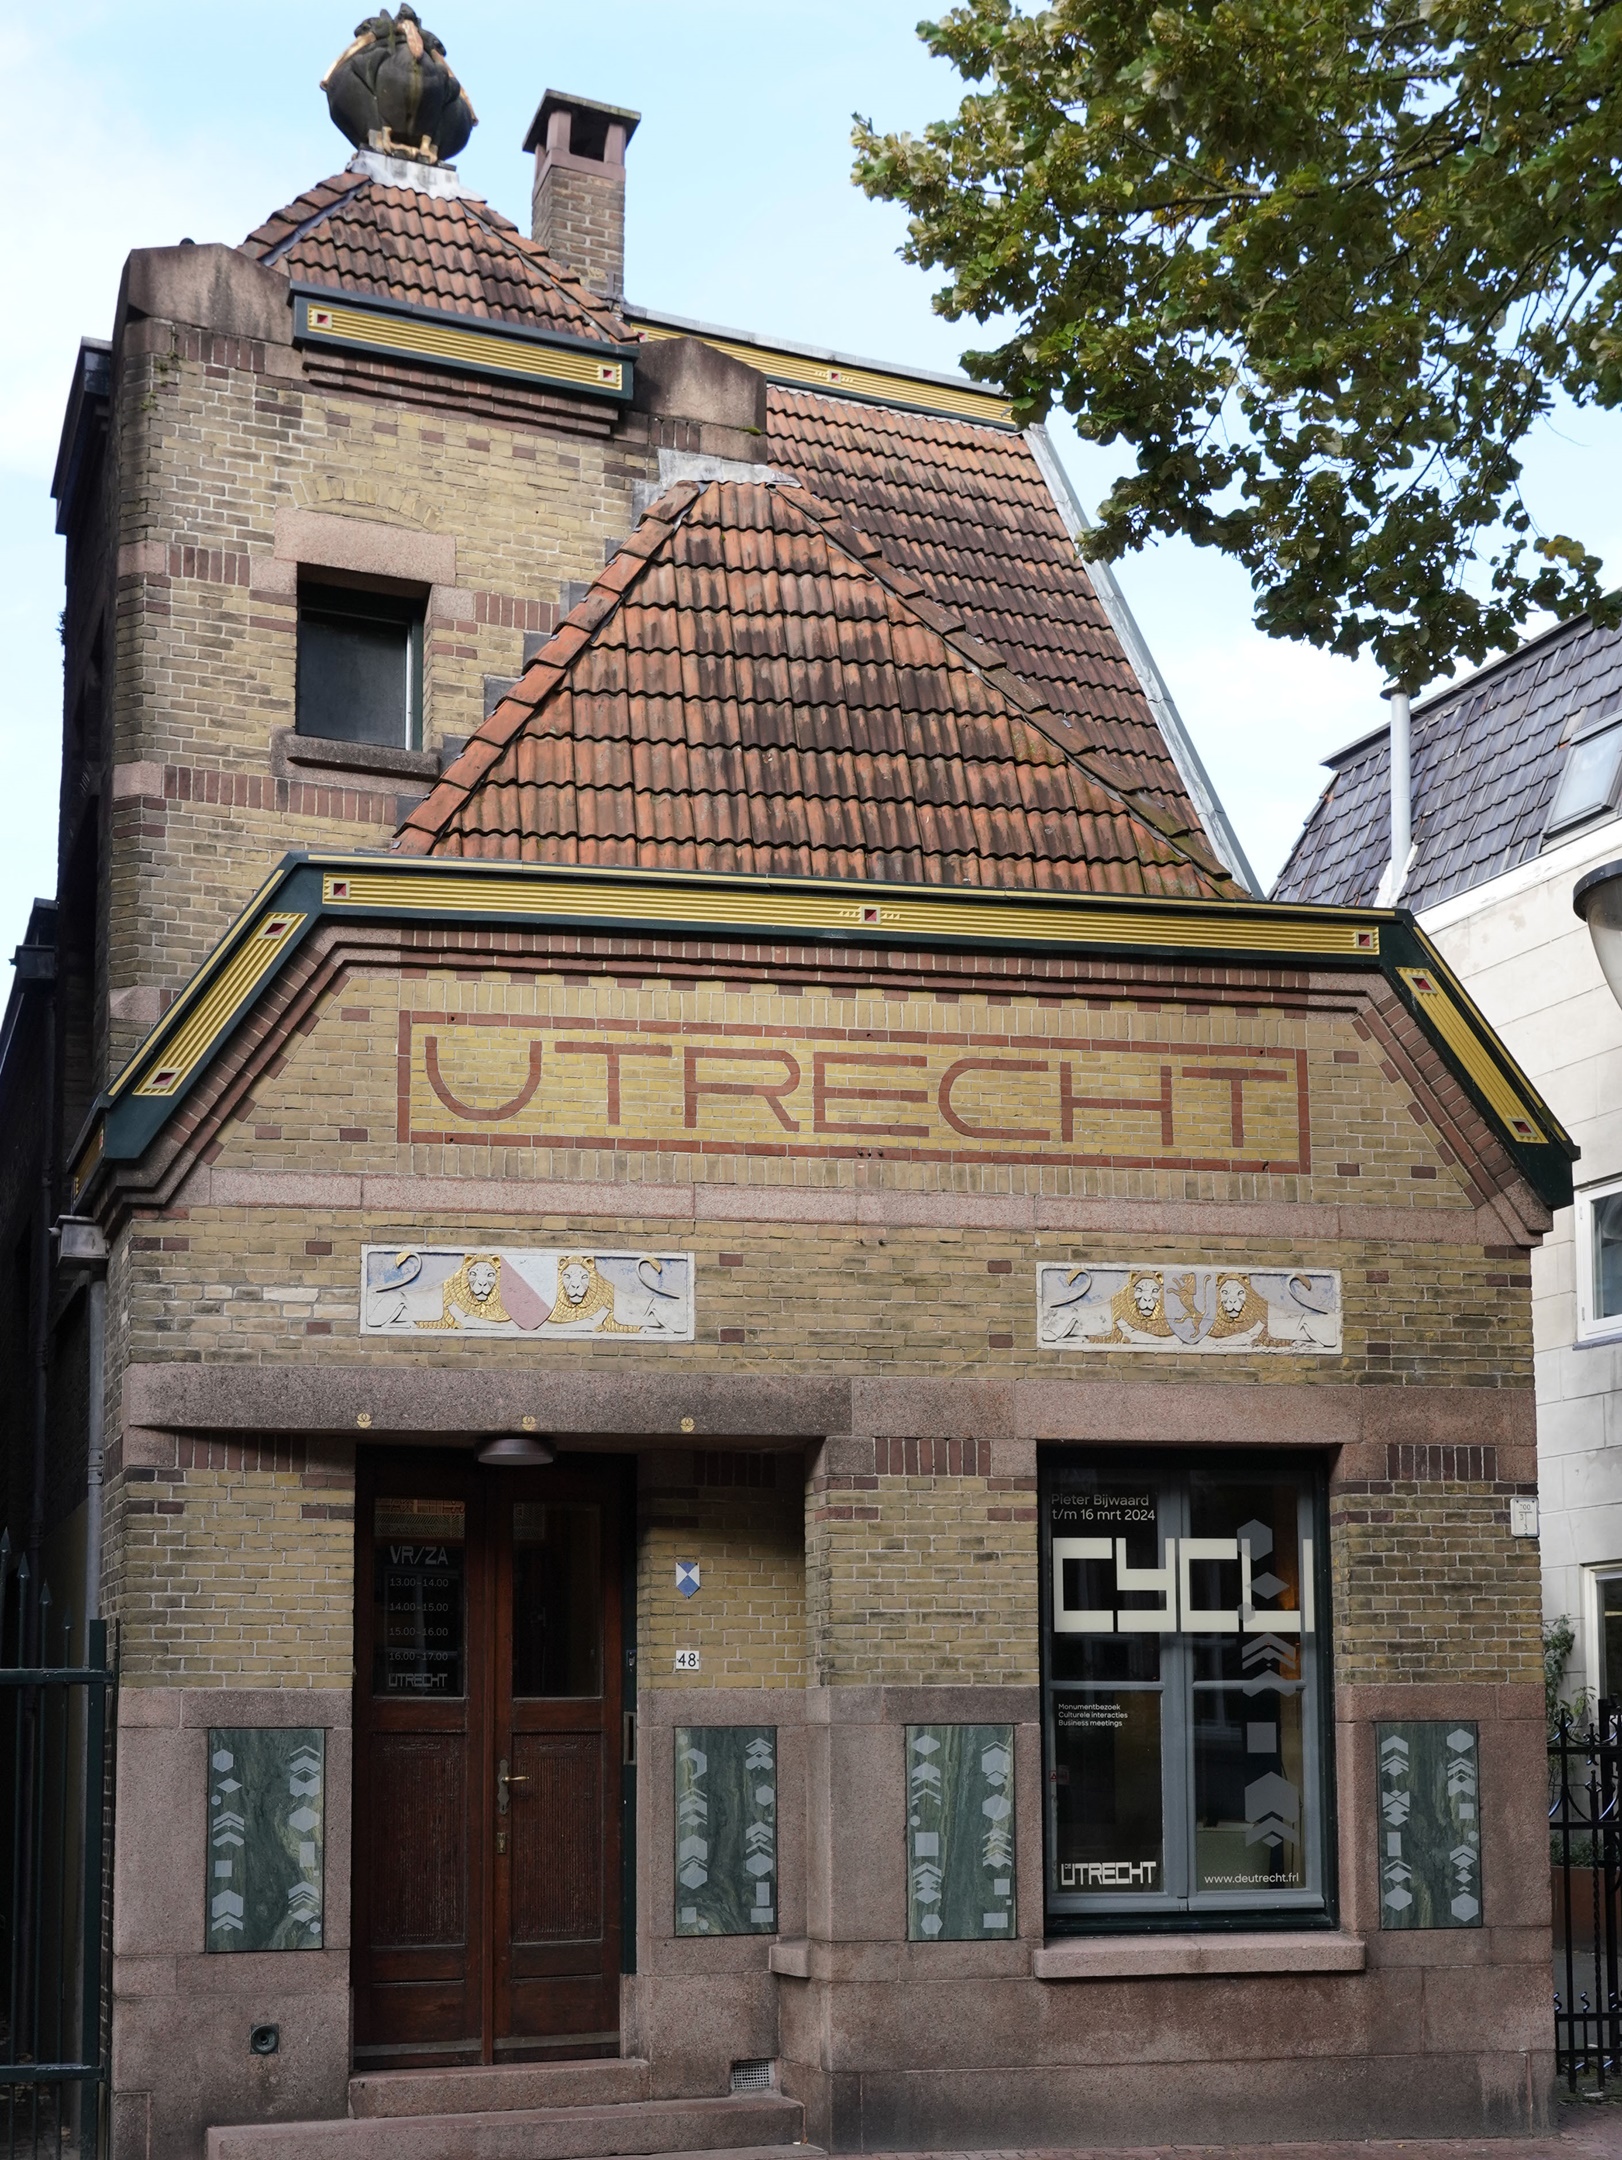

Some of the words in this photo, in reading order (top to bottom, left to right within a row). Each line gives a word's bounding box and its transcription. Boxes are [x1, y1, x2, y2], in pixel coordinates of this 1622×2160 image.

[424, 1035, 1287, 1148] UTRECHT
[1051, 1493, 1090, 1505] Pieter
[1093, 1493, 1149, 1508] Bijwaard
[1051, 1508, 1078, 1520] t/m
[1080, 1508, 1095, 1520] 16
[1097, 1509, 1122, 1521] mrt
[1124, 1509, 1156, 1521] 2024
[389, 1545, 449, 1565] VR/ZA
[678, 1653, 697, 1667] 48
[388, 1673, 448, 1688] UTRECHT
[1058, 1703, 1121, 1711] Monumentbezoek
[1058, 1711, 1090, 1719] Culturele
[1091, 1711, 1128, 1719] interacties
[1058, 1719, 1089, 1727] Business
[1090, 1719, 1123, 1729] meetings
[1061, 1861, 1157, 1886] UTRECHT
[1204, 1872, 1299, 1884] www.deutrecht.frl
